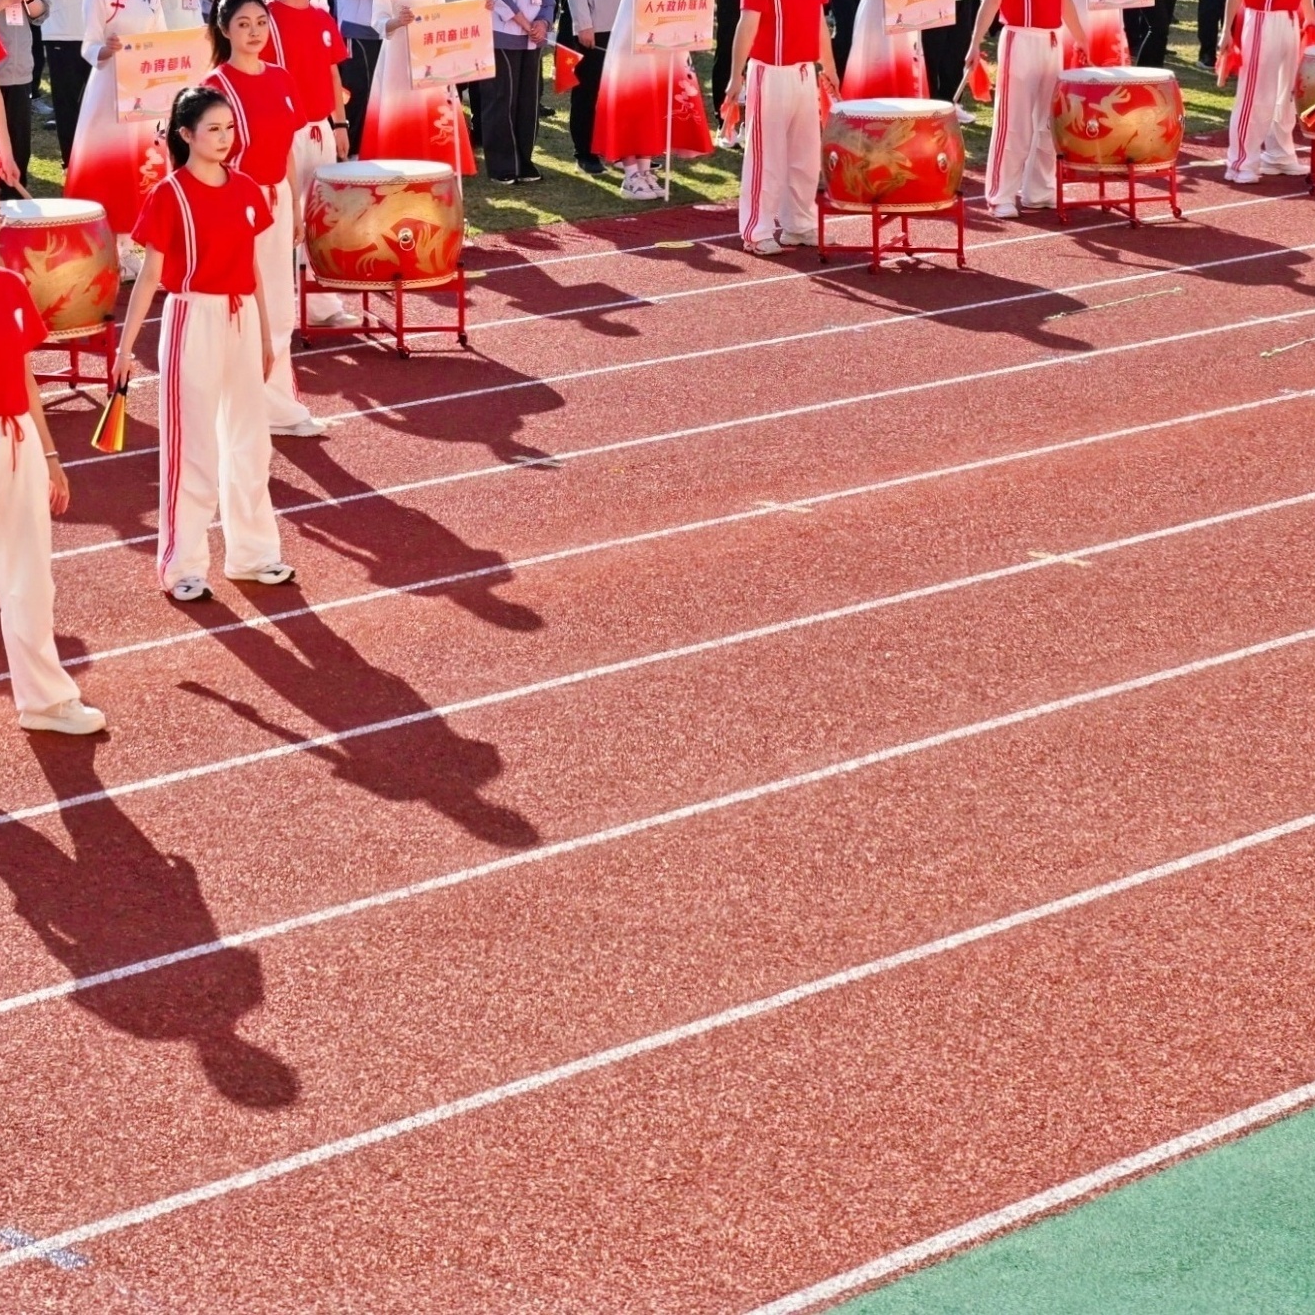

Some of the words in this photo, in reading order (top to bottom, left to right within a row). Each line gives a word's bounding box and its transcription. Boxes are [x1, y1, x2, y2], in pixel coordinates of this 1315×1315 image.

[423, 25, 481, 46] 清风奋进队
